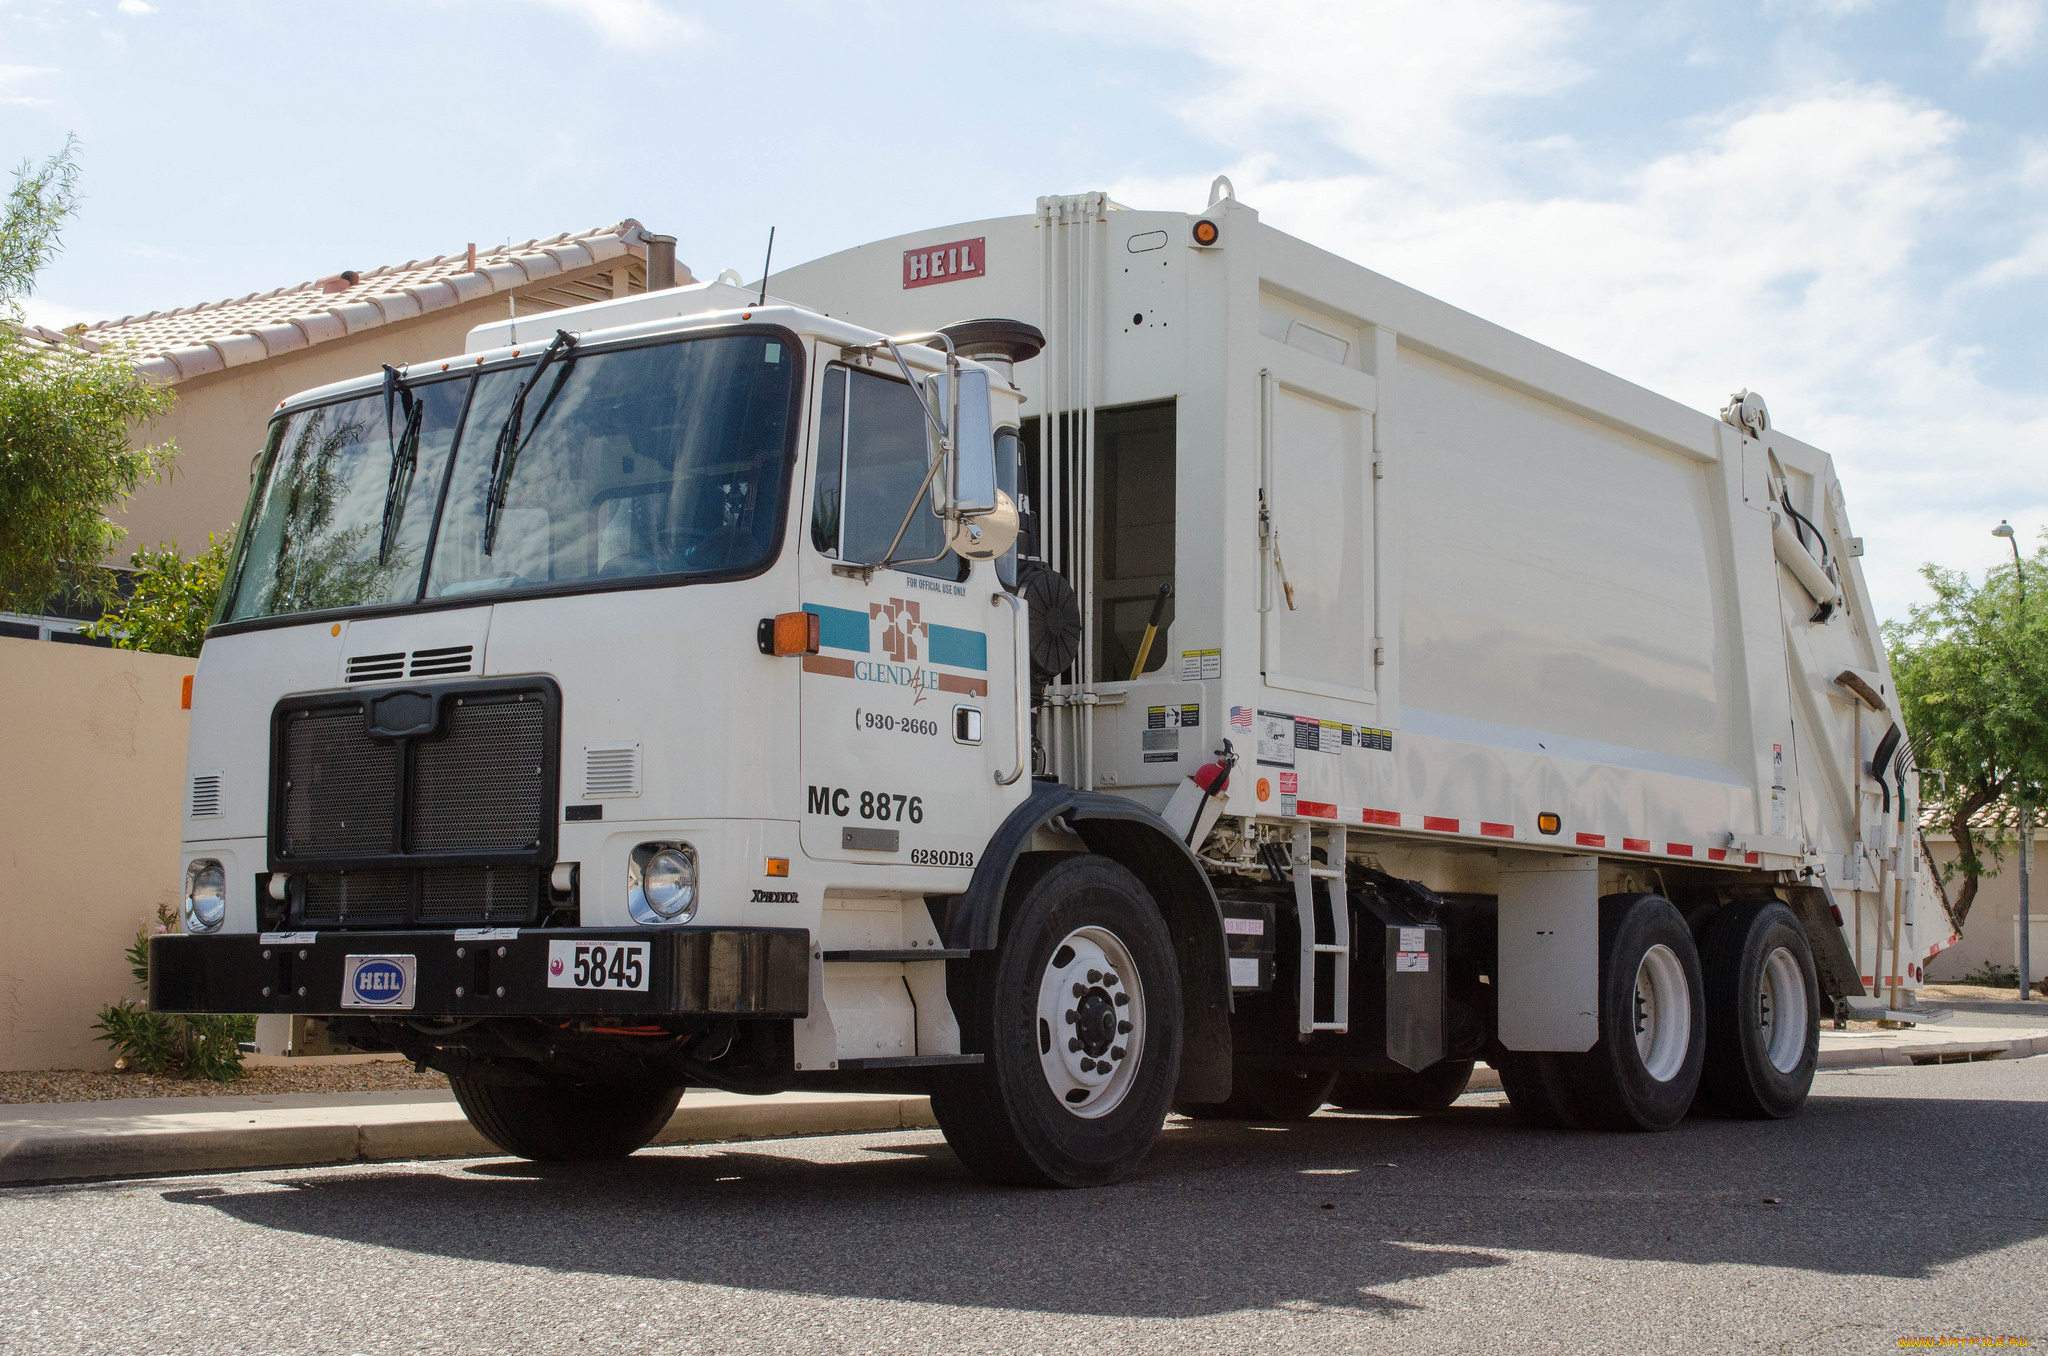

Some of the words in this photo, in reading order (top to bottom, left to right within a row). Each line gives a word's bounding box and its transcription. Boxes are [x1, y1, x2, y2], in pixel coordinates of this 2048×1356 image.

[910, 246, 976, 281] HEIL
[906, 577, 918, 588] FOR
[918, 579, 941, 593] OFFICIAL
[942, 583, 953, 595] USE
[953, 585, 967, 597] ONLY
[855, 661, 939, 691] GLENDALE
[865, 712, 938, 737] 930-2660
[808, 785, 850, 818] MC
[860, 790, 923, 824] 8876
[911, 848, 974, 867] 6280D13
[1225, 920, 1235, 931] DO
[1236, 920, 1247, 932] NOT
[1247, 921, 1263, 933] STEP
[573, 946, 643, 988] 5845
[360, 972, 401, 990] HEIL
